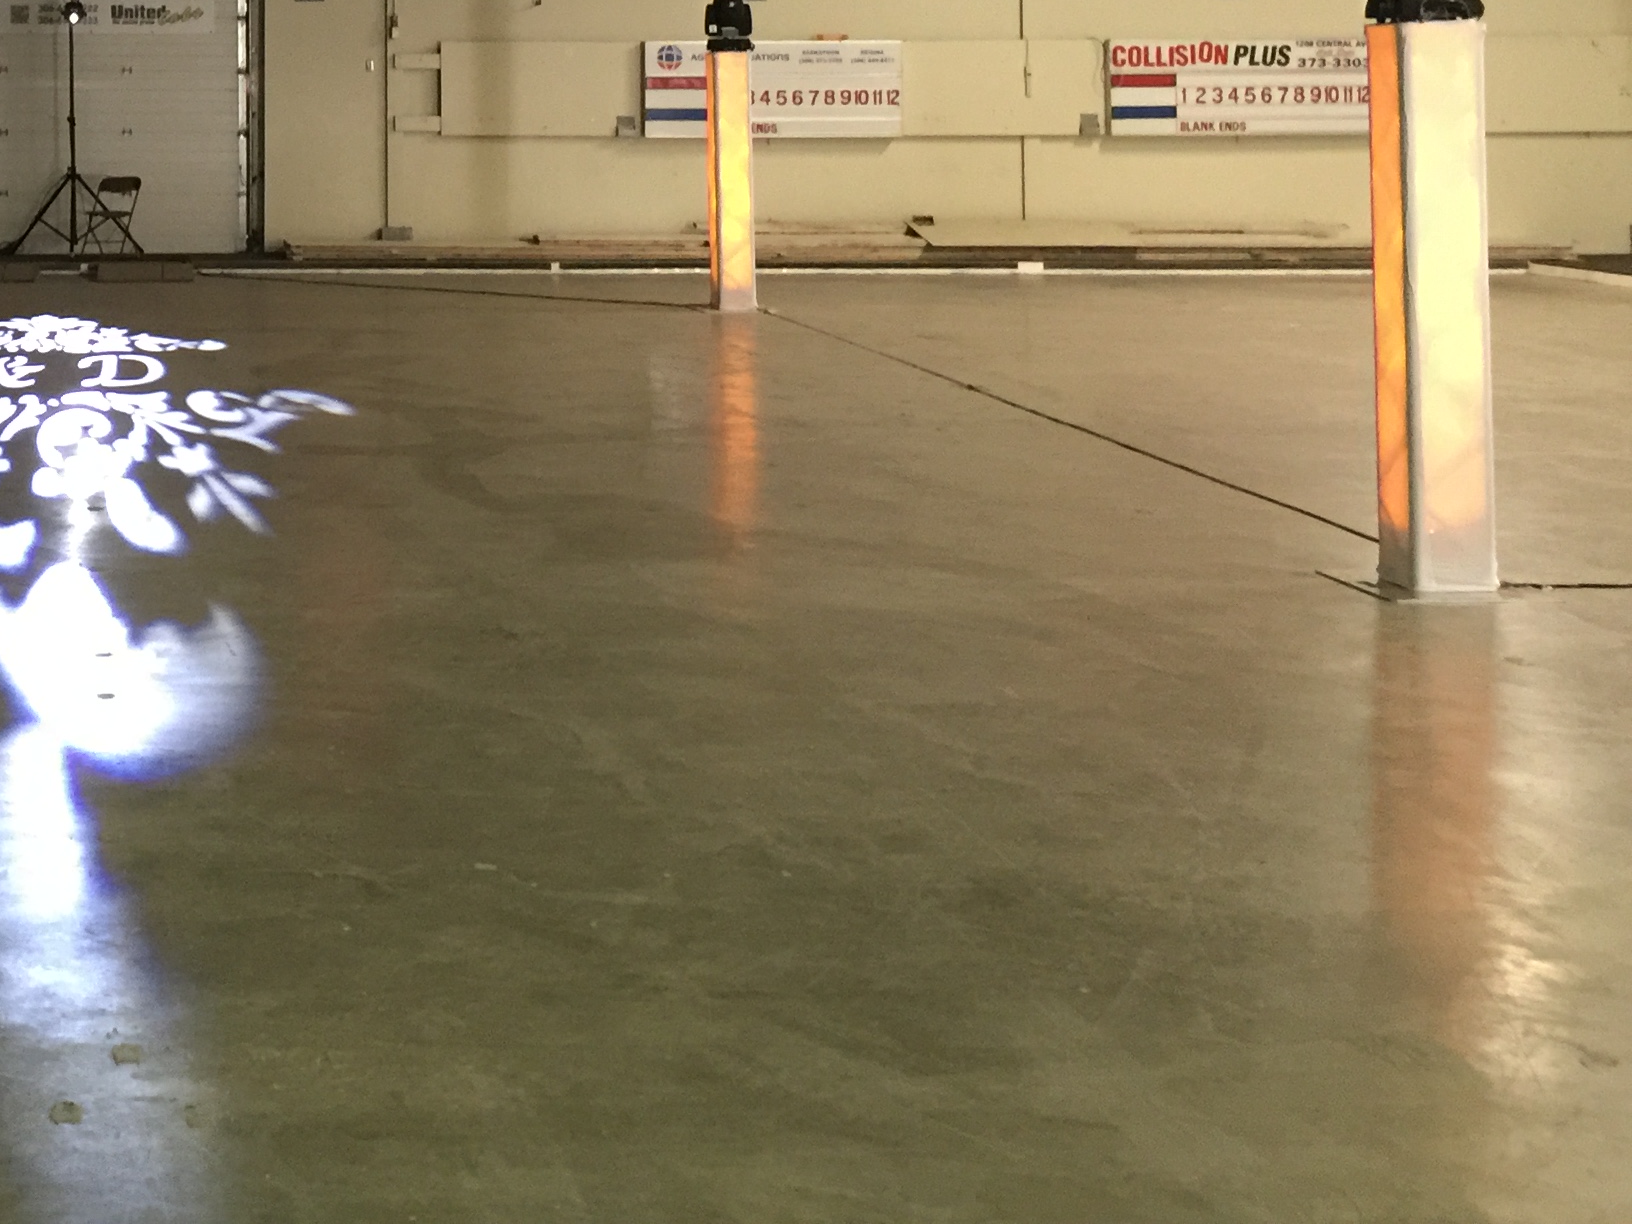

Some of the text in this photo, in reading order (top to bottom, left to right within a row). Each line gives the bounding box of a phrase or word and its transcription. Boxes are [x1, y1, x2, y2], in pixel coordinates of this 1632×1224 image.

[110, 5, 166, 19] United
[1111, 41, 1292, 67] COLLISION PLUS
[760, 90, 900, 106] 4 5 6 7 8 9 10 11 12
[1196, 87, 1206, 104] 2
[1212, 87, 1223, 104] 3
[1228, 87, 1240, 104] 4
[1245, 87, 1256, 104] 5
[1261, 87, 1272, 104] 6
[1278, 87, 1289, 104] 7
[1294, 87, 1305, 104] 8
[1310, 87, 1321, 104] 9
[1325, 87, 1339, 104] 10
[1344, 87, 1353, 104] 11
[1357, 87, 1370, 104] 12
[1180, 122, 1247, 132] BLANK ENDS
[77, 354, 167, 388] D
